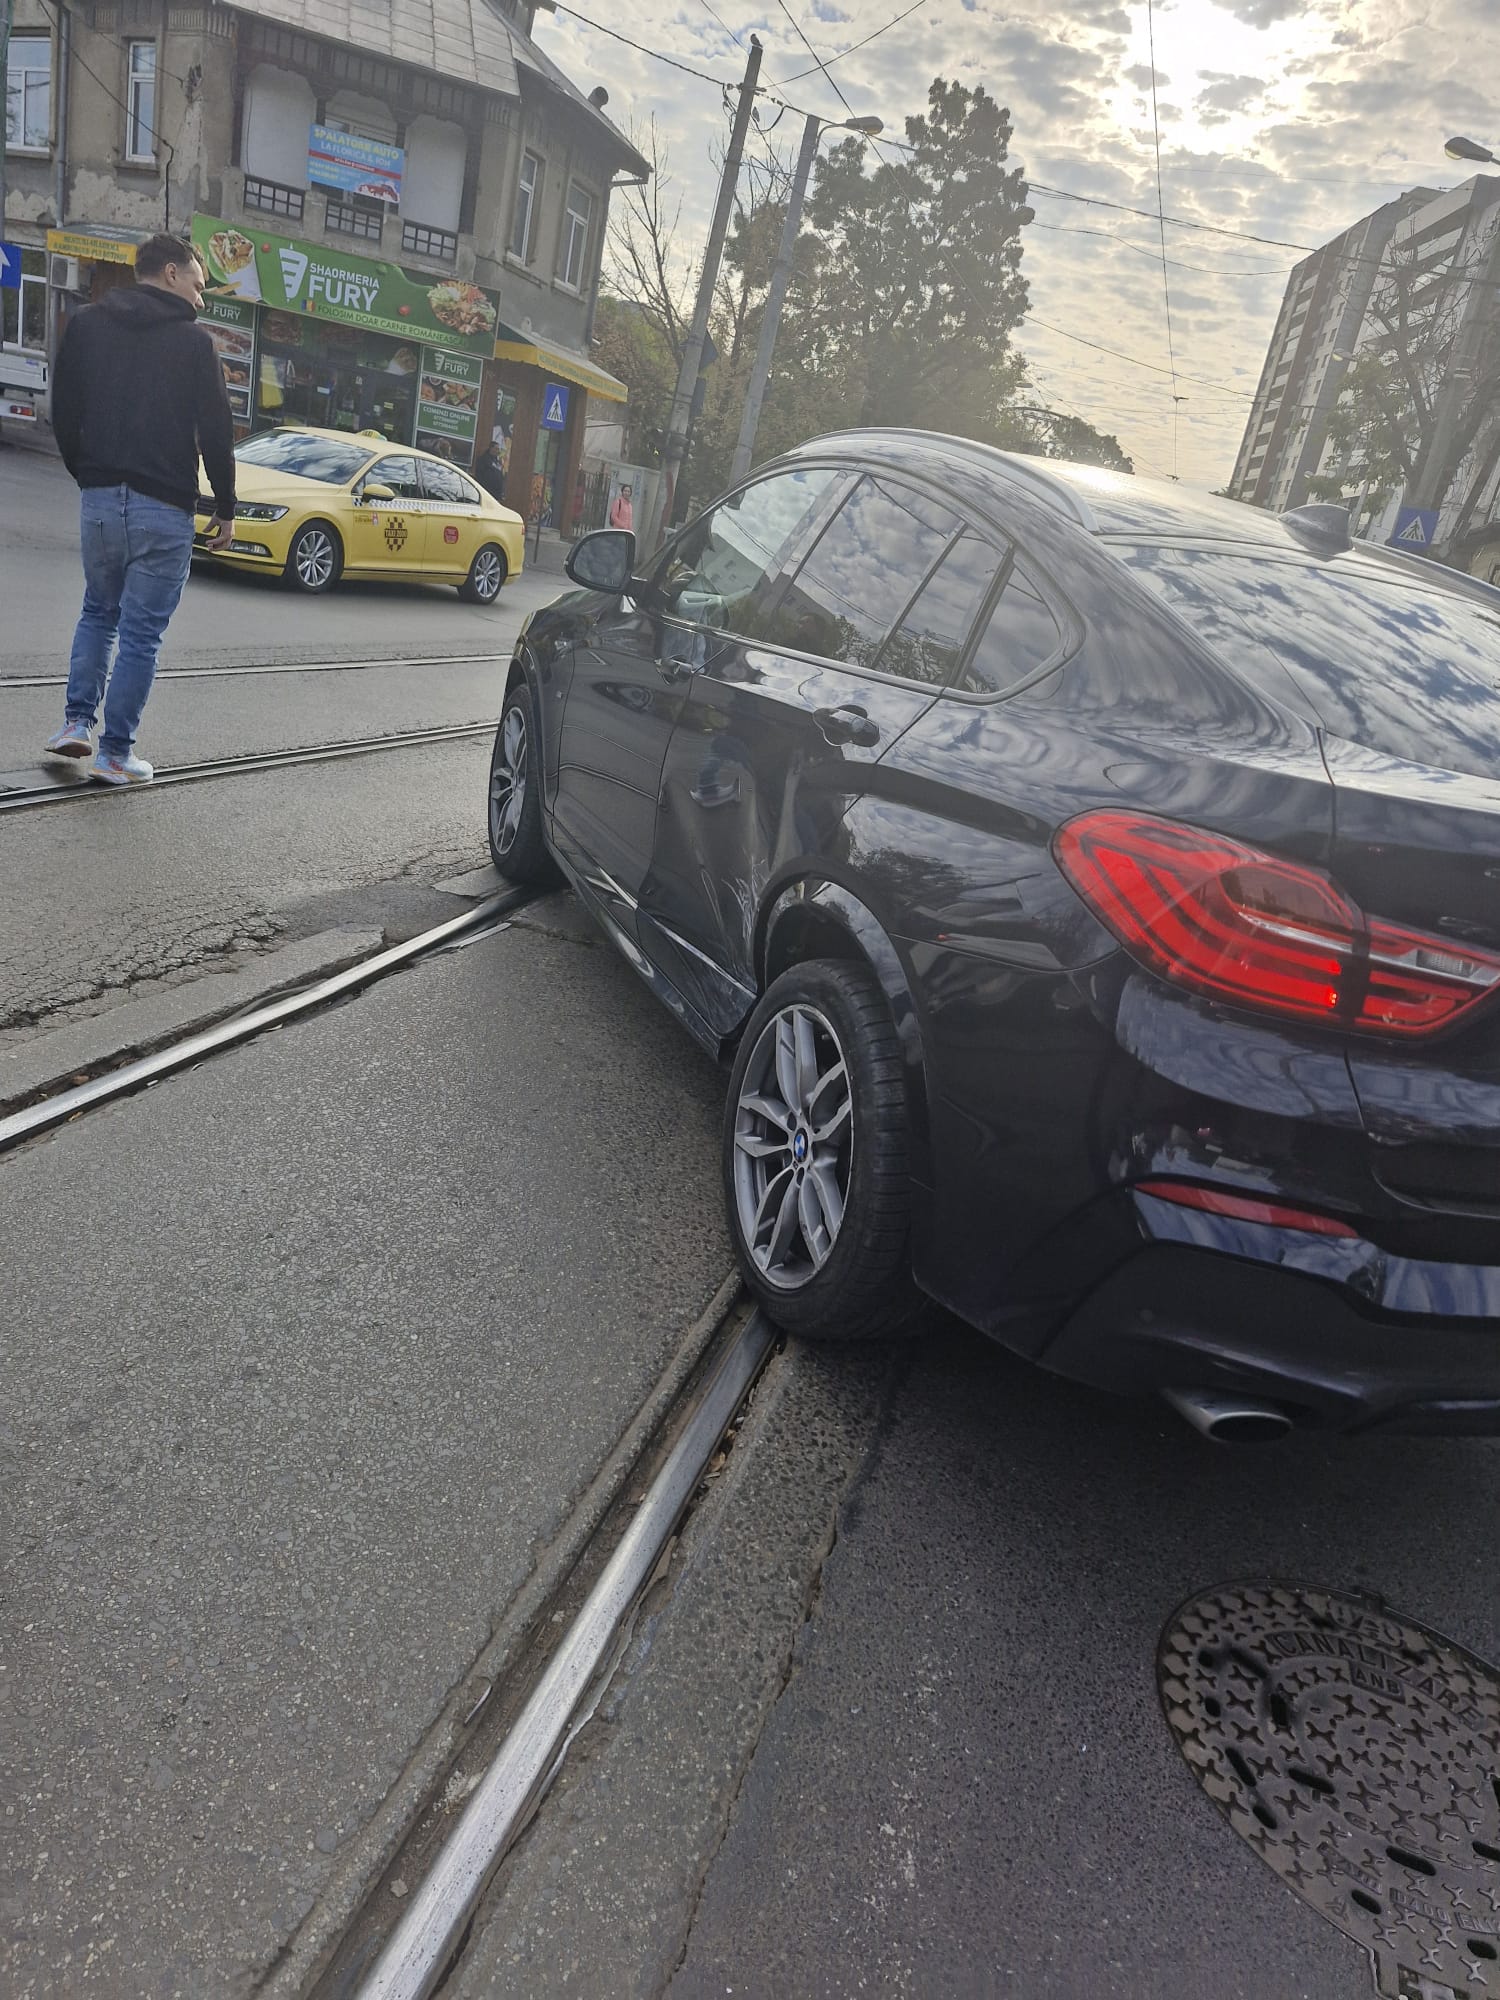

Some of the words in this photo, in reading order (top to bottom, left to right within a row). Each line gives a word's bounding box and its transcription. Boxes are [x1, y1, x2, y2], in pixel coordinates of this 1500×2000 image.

[321, 141, 332, 151] LA
[372, 145, 400, 160] AUTO
[309, 262, 380, 290] SHAORMERIA
[308, 274, 379, 312] FURY
[213, 306, 241, 321] FURY
[318, 304, 354, 321] FOLOSIM
[355, 314, 378, 326] DOAR
[380, 319, 408, 333] CARNE
[443, 362, 470, 376] FURY
[423, 406, 449, 418] COMENZI
[449, 411, 470, 422] ONLINE
[385, 529, 396, 538] TAXI
[1268, 1632, 1485, 1732] CANALIZARE
[1356, 1667, 1400, 1694] ANB
